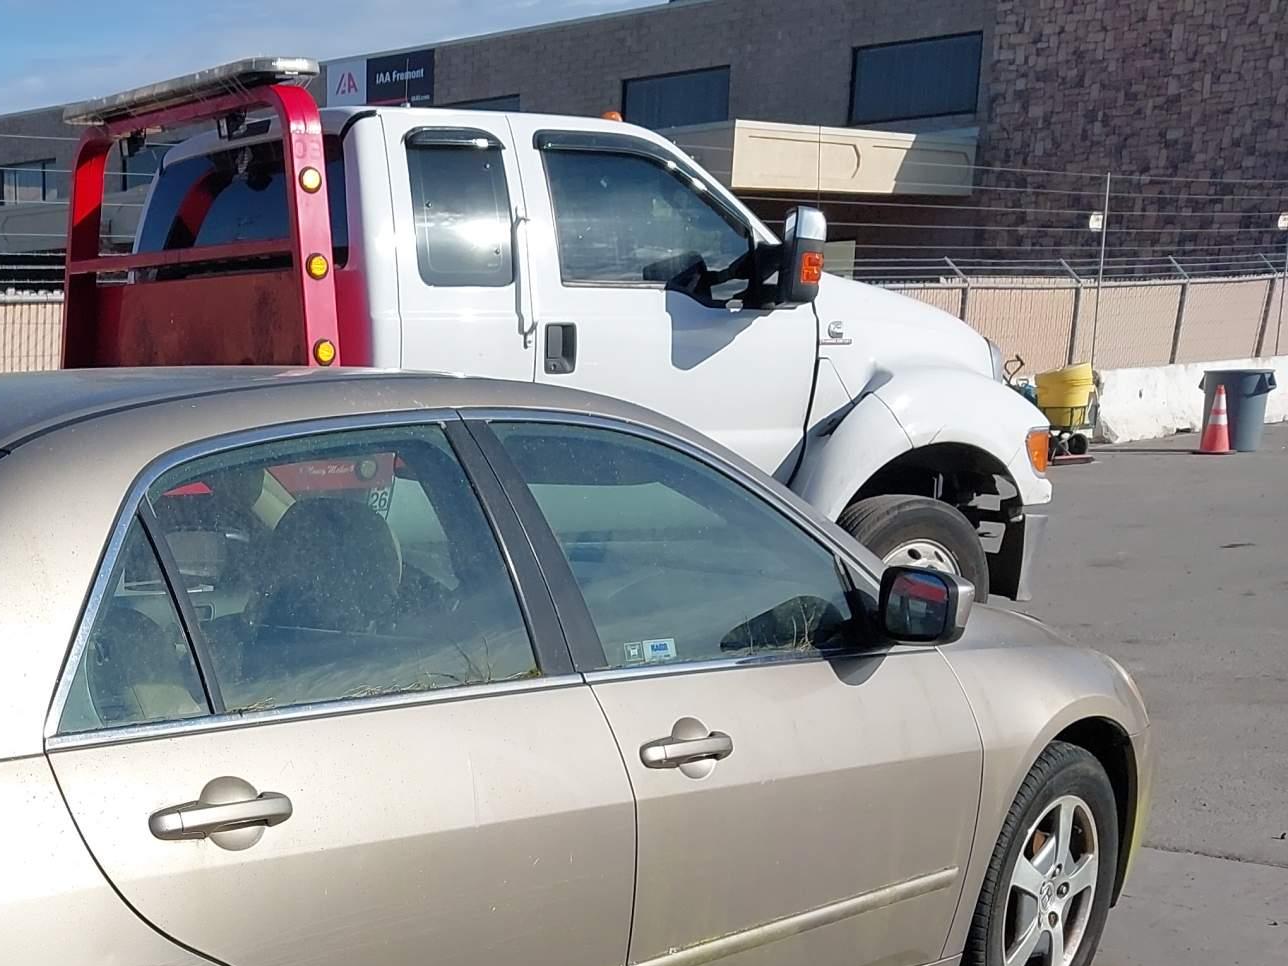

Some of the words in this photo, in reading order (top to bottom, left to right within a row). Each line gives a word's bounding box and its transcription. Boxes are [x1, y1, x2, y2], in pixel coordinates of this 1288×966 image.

[376, 71, 391, 84] IAA
[393, 68, 424, 82] Fremont
[371, 490, 388, 509] 26
